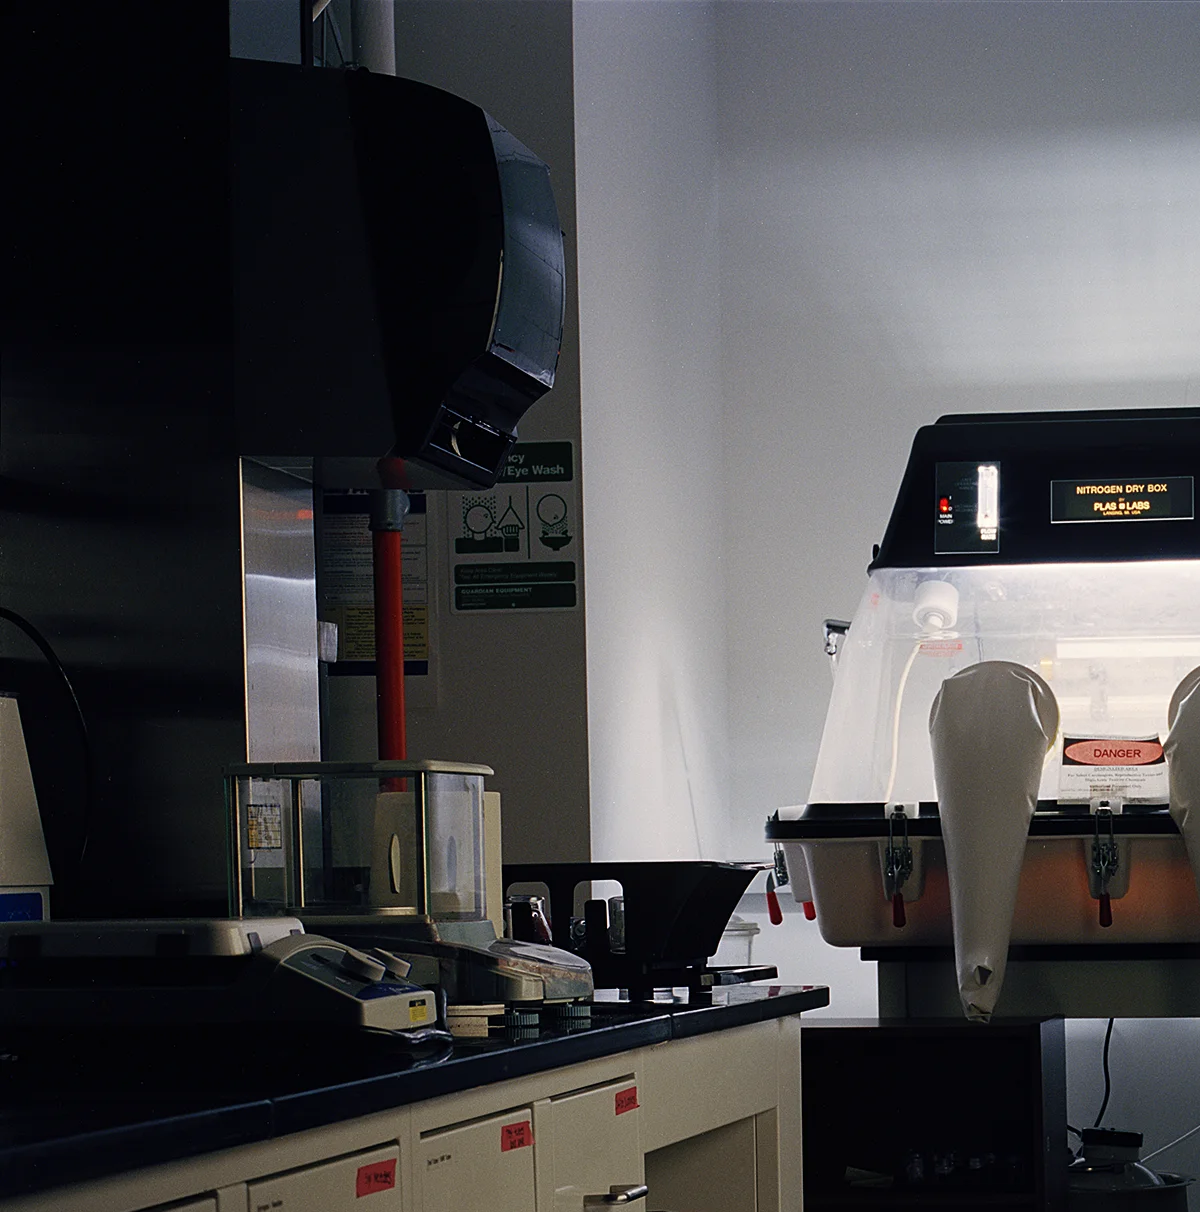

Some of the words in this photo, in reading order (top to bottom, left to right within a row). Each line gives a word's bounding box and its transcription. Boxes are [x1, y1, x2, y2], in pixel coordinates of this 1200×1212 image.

[531, 464, 565, 475] Wash
[1076, 485, 1123, 495] NITROGEN
[1125, 484, 1145, 494] DRY
[1147, 483, 1168, 493] BOX
[1093, 502, 1117, 511] PLAS
[1126, 501, 1150, 510] LABS
[1093, 748, 1141, 758] DANGER
